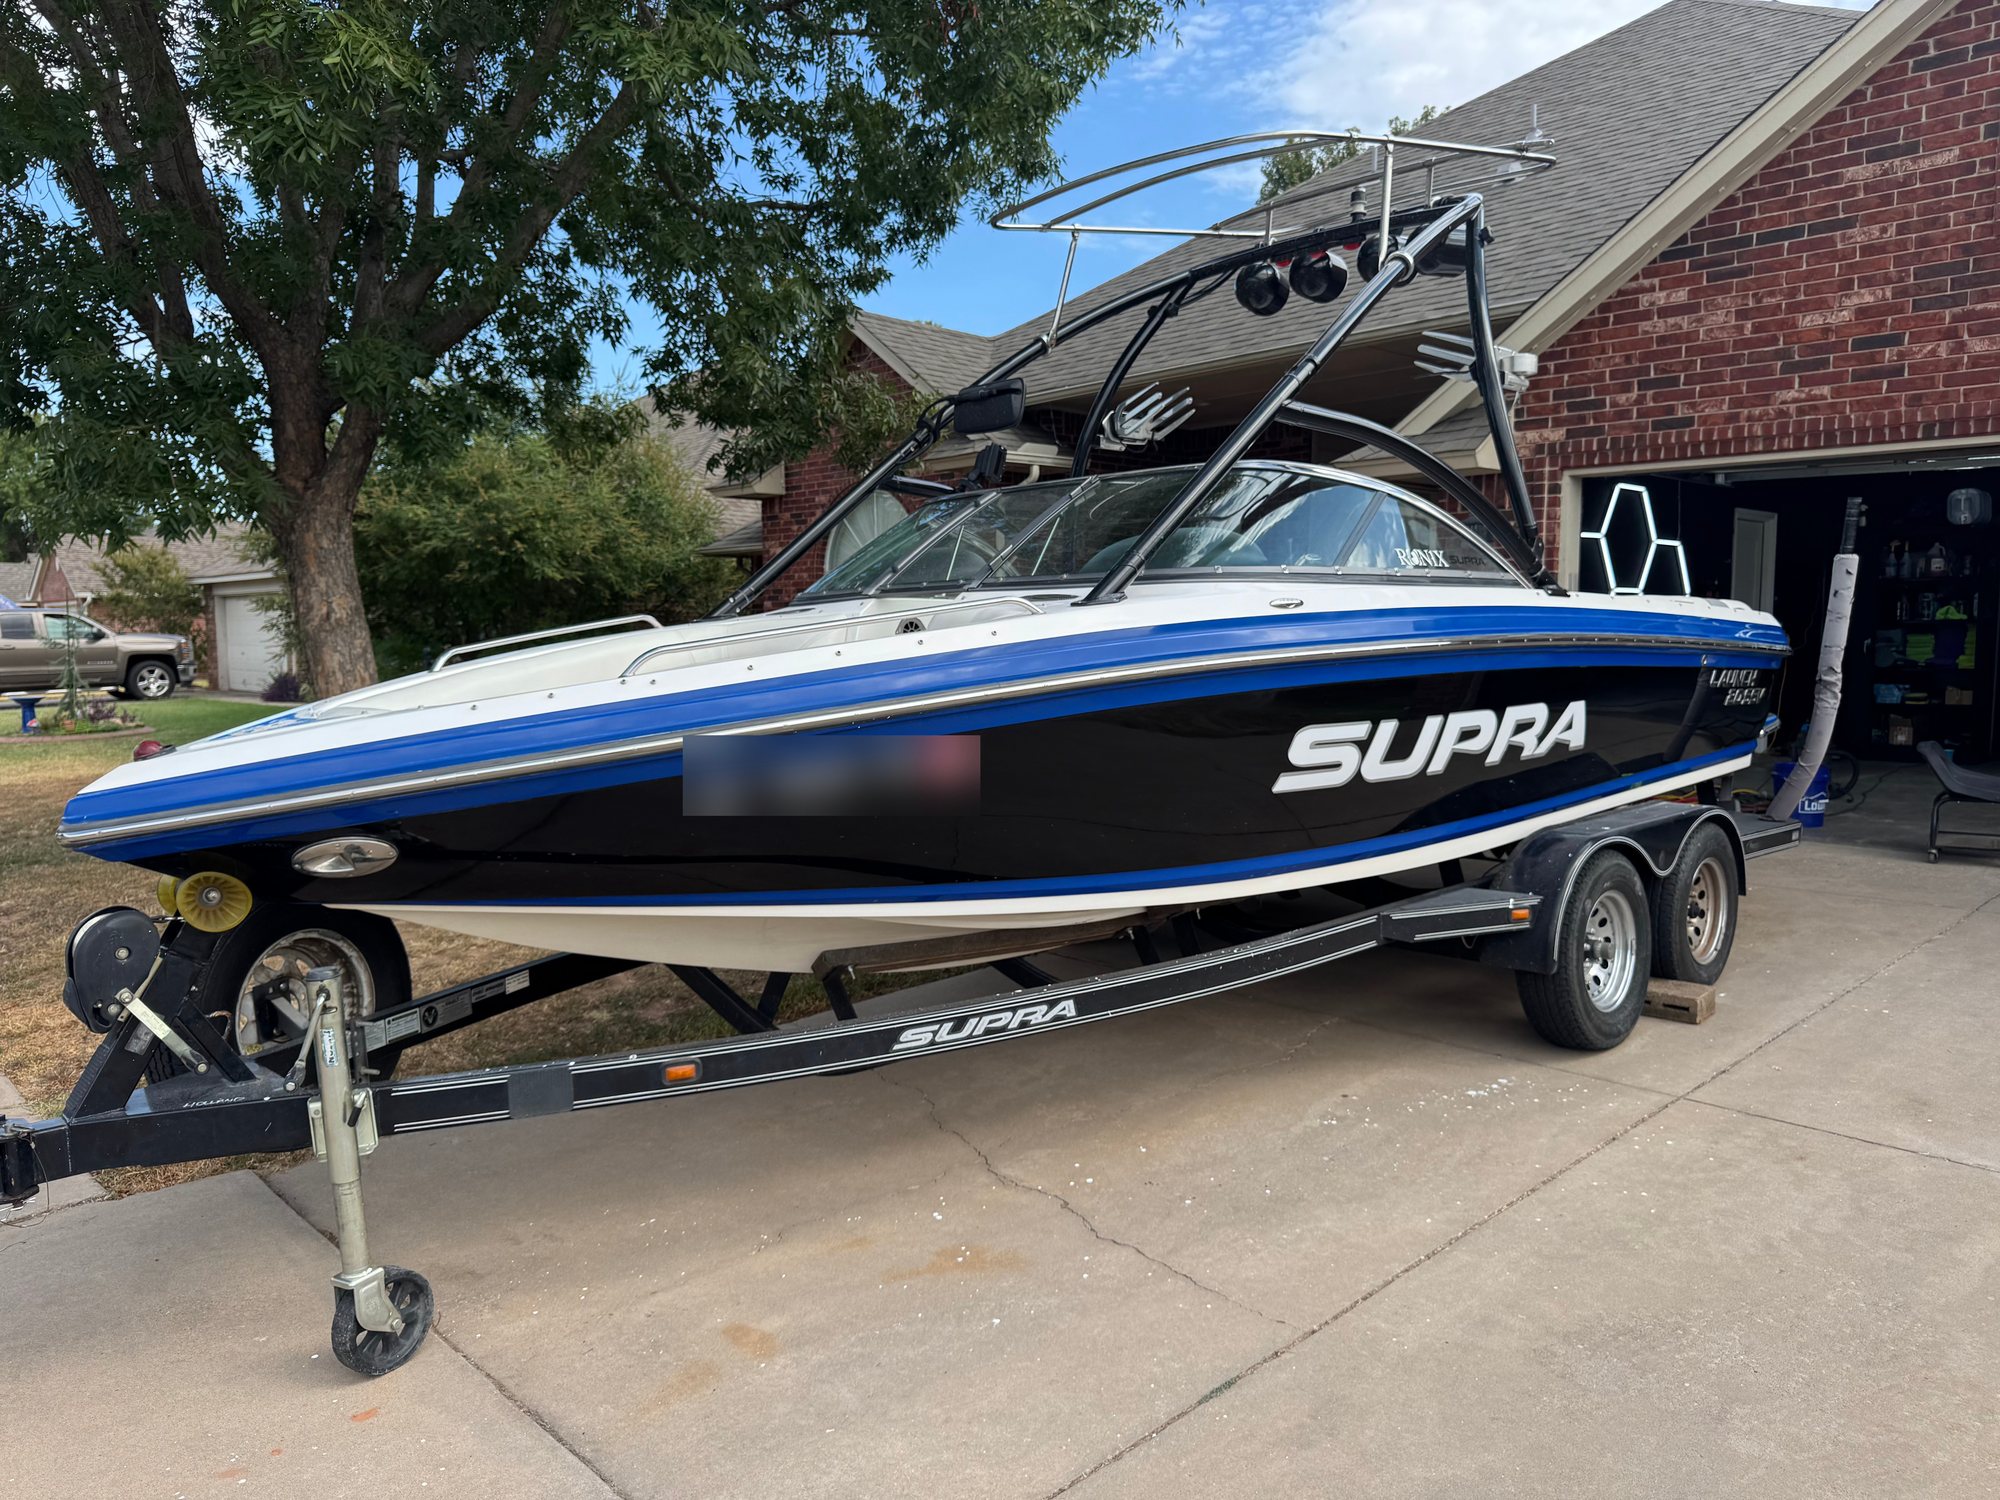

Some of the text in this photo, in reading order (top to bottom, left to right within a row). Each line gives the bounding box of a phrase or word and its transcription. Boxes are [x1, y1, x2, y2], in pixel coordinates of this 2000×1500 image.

[1394, 547, 1450, 568] RONIX
[1448, 555, 1487, 567] SUPRA
[1271, 700, 1587, 794] SUPRA
[890, 999, 1079, 1052] SUPRA
